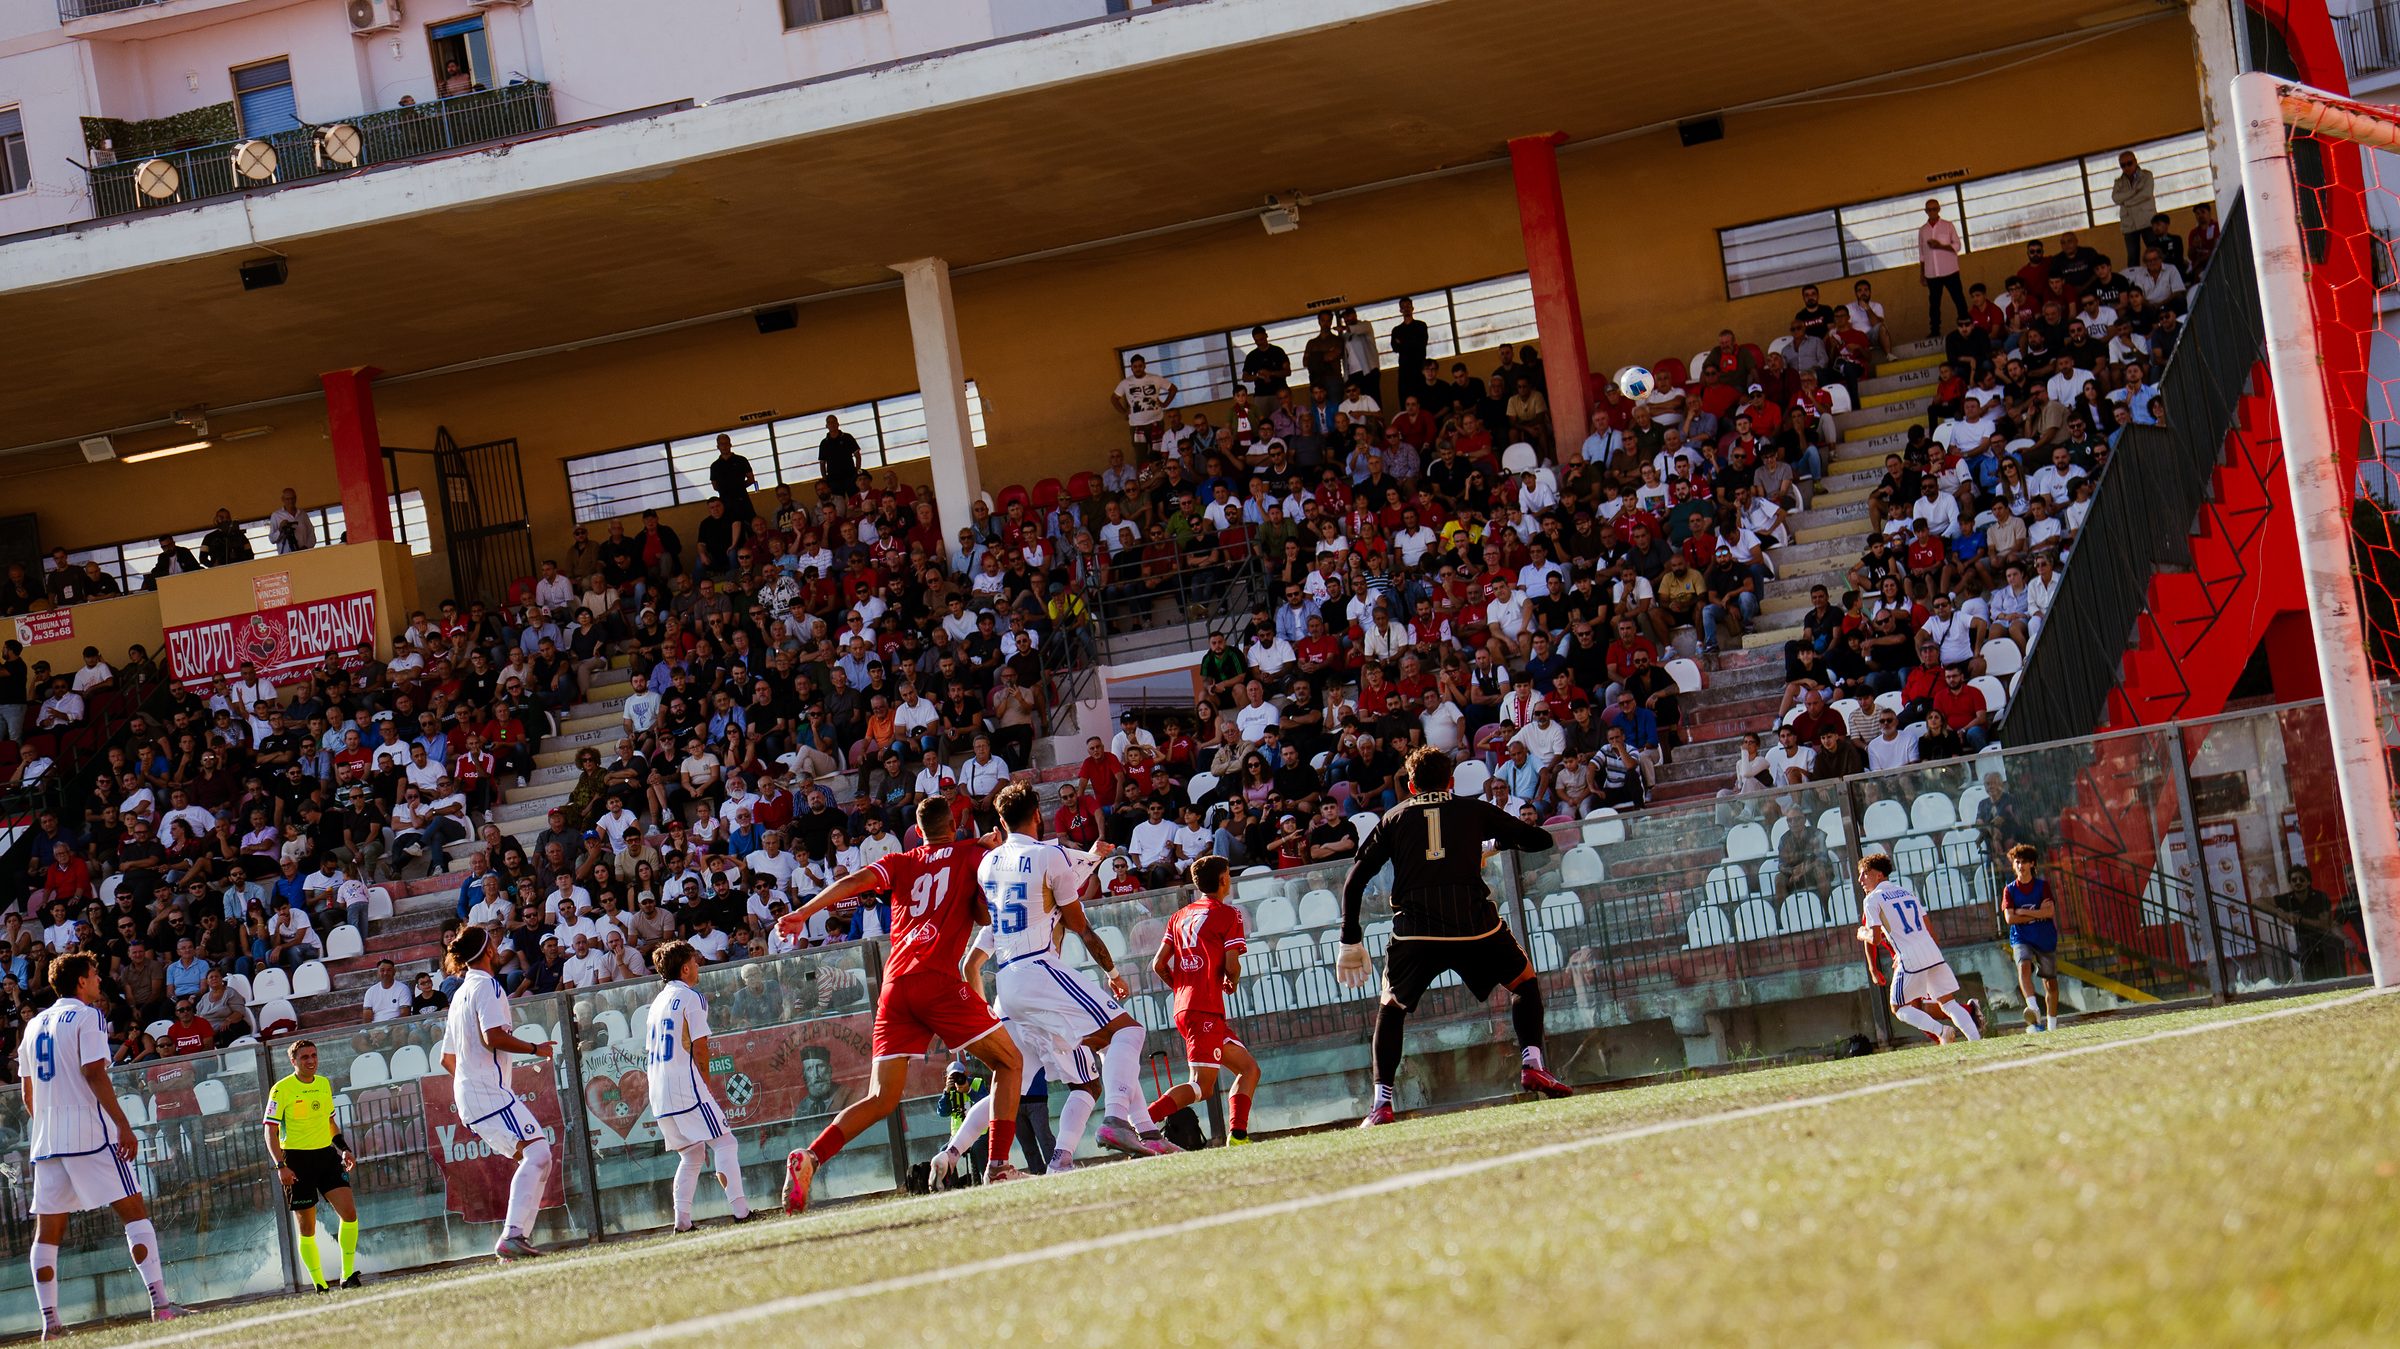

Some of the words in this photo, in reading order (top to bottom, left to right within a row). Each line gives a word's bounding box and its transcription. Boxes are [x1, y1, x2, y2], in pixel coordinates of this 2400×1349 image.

[1914, 341, 1933, 350] FILA
[1899, 373, 1919, 382] FILA
[1919, 370, 1930, 379] 16
[1884, 404, 1904, 414] FILA
[1905, 401, 1916, 410] 15
[1868, 438, 1888, 448] FILA
[1889, 435, 1900, 444] 14
[1852, 472, 1872, 482] FILA
[33, 620, 60, 631] TRIBUNA
[60, 618, 70, 627] VIP
[43, 629, 55, 639] 35
[60, 626, 71, 636] 68
[168, 622, 235, 679] GRUPPO
[575, 732, 592, 742] FILA
[1408, 791, 1453, 807] NEGRI
[1423, 807, 1446, 861] 1
[909, 866, 951, 918] 91
[835, 899, 858, 909] turris
[1892, 899, 1923, 935] 17
[176, 1036, 202, 1048] turris
[35, 1032, 56, 1083] 9
[158, 1069, 183, 1083] turris
[724, 1106, 747, 1119] 1944
